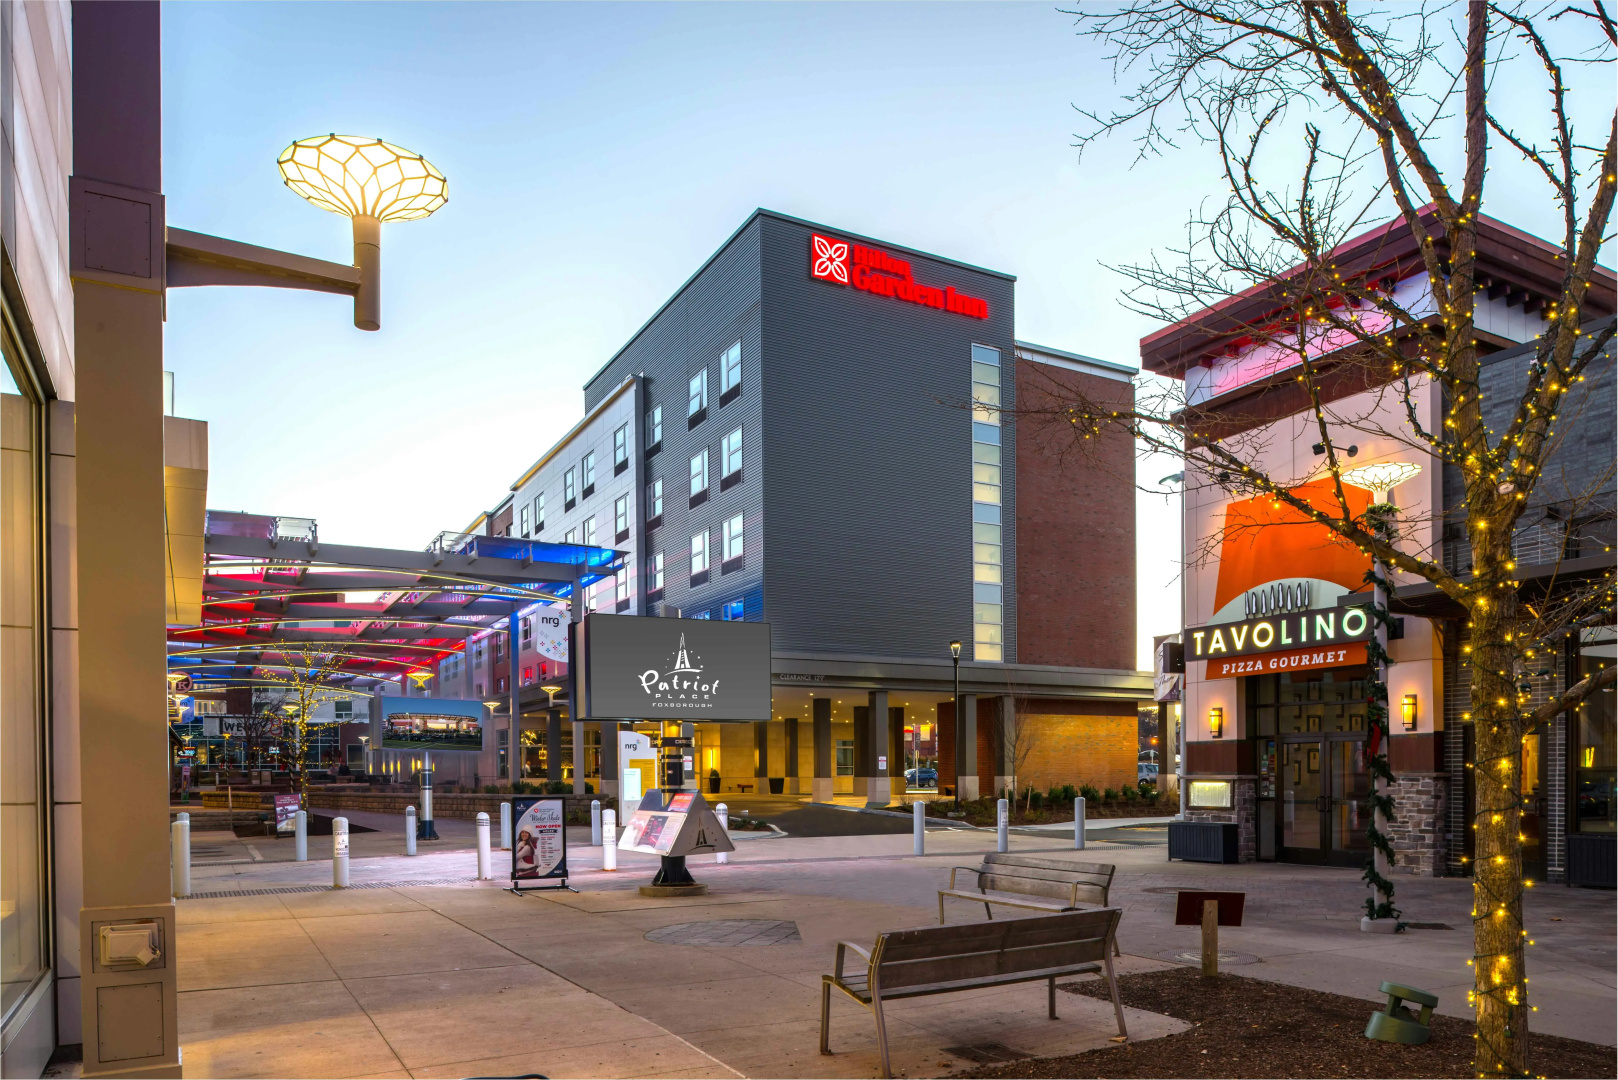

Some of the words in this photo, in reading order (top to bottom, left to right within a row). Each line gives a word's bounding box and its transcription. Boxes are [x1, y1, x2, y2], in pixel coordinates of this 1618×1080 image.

[853, 244, 911, 276] Hilton
[852, 264, 944, 309] Garden
[946, 285, 988, 319] Inn
[541, 616, 560, 628] nrg
[1192, 608, 1367, 656] TAVOLINO
[1221, 658, 1264, 675] PIZZA
[1268, 649, 1347, 669] GOURMET
[638, 669, 720, 695] Patriot
[779, 673, 812, 681] CLEARANCE
[624, 743, 638, 751] nrg
